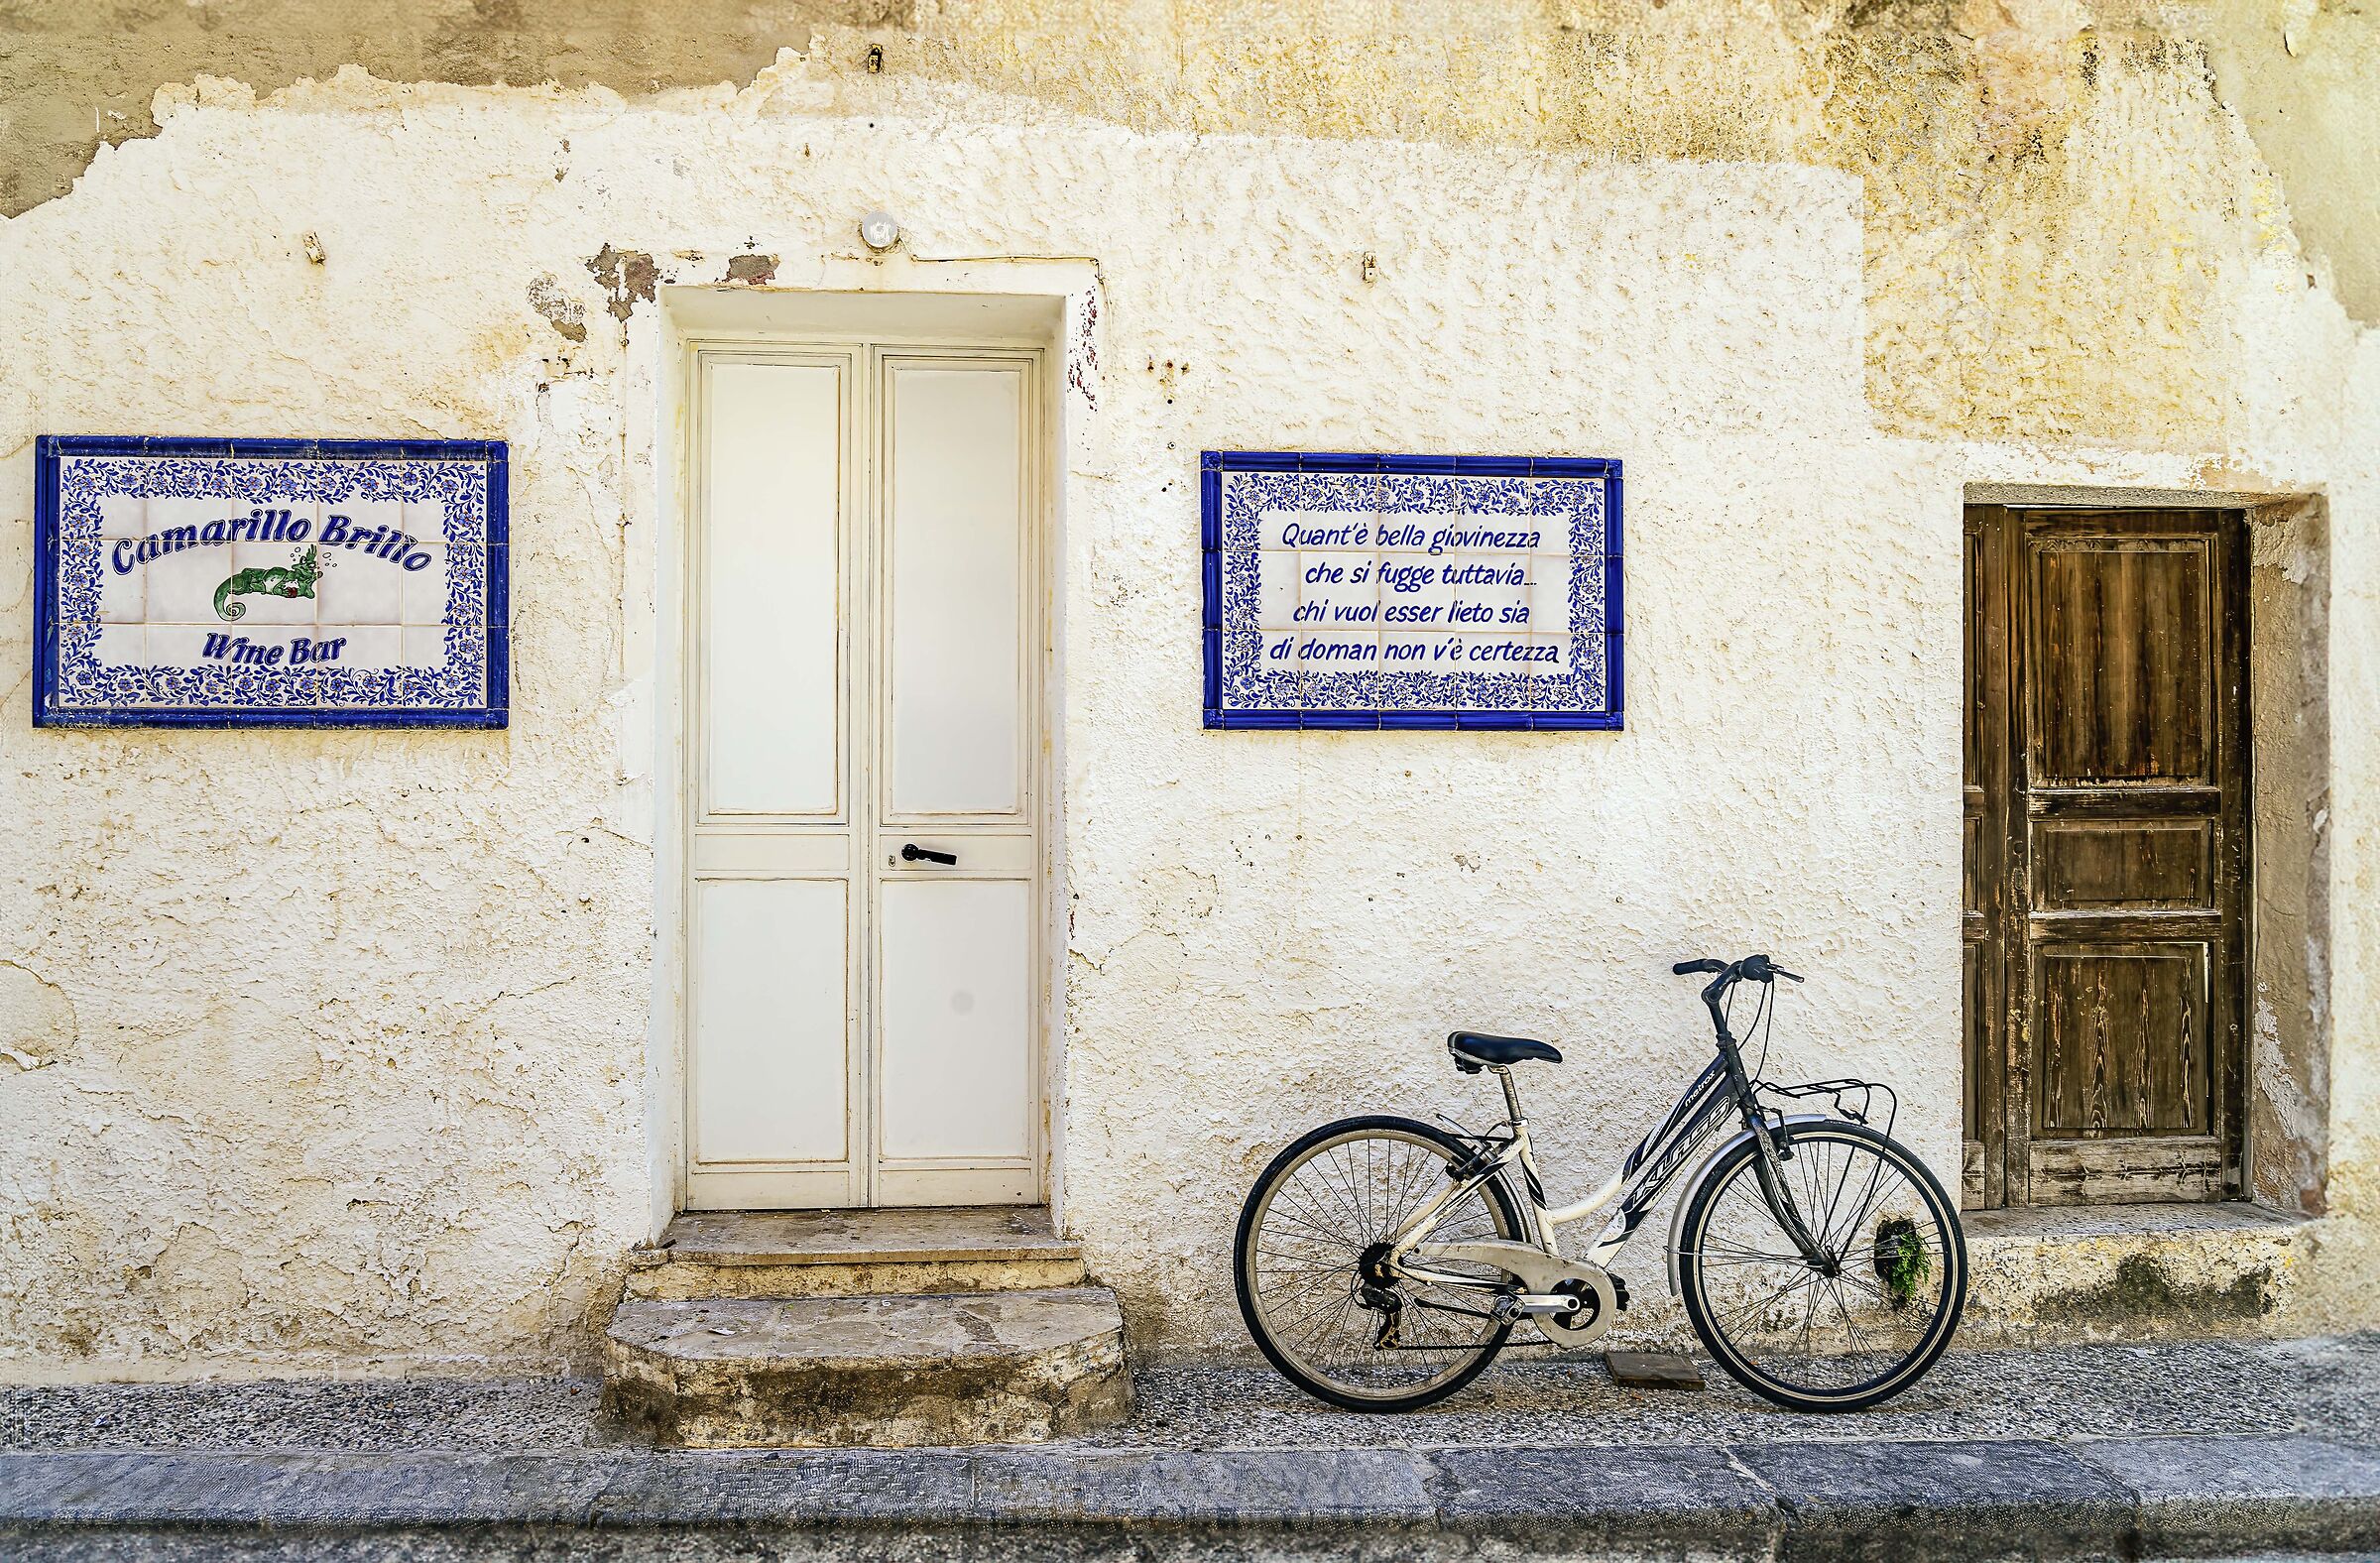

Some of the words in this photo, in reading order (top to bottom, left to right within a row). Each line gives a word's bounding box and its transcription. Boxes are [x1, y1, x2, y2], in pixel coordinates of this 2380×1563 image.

[112, 509, 311, 575] Camarillo
[319, 514, 431, 572] Brillo
[1282, 524, 1368, 548] Quant'è
[1375, 524, 1424, 546] bella
[1428, 524, 1540, 555] giovinezza
[1305, 561, 1345, 584] che
[1350, 560, 1370, 583] si
[1376, 562, 1434, 592] fugge
[1442, 562, 1537, 586] tuttavia...
[1293, 598, 1328, 622] chi
[1335, 599, 1379, 622] vuol
[1384, 605, 1443, 623] esser
[1448, 600, 1492, 623] lieto
[1499, 600, 1529, 624] sia
[202, 633, 284, 664] Wine
[291, 637, 346, 664] Bar
[1270, 637, 1293, 660] di
[1298, 638, 1375, 661] doman
[1384, 645, 1426, 661] non
[1470, 642, 1559, 663] certezza
[1685, 1070, 1716, 1107] metrox
